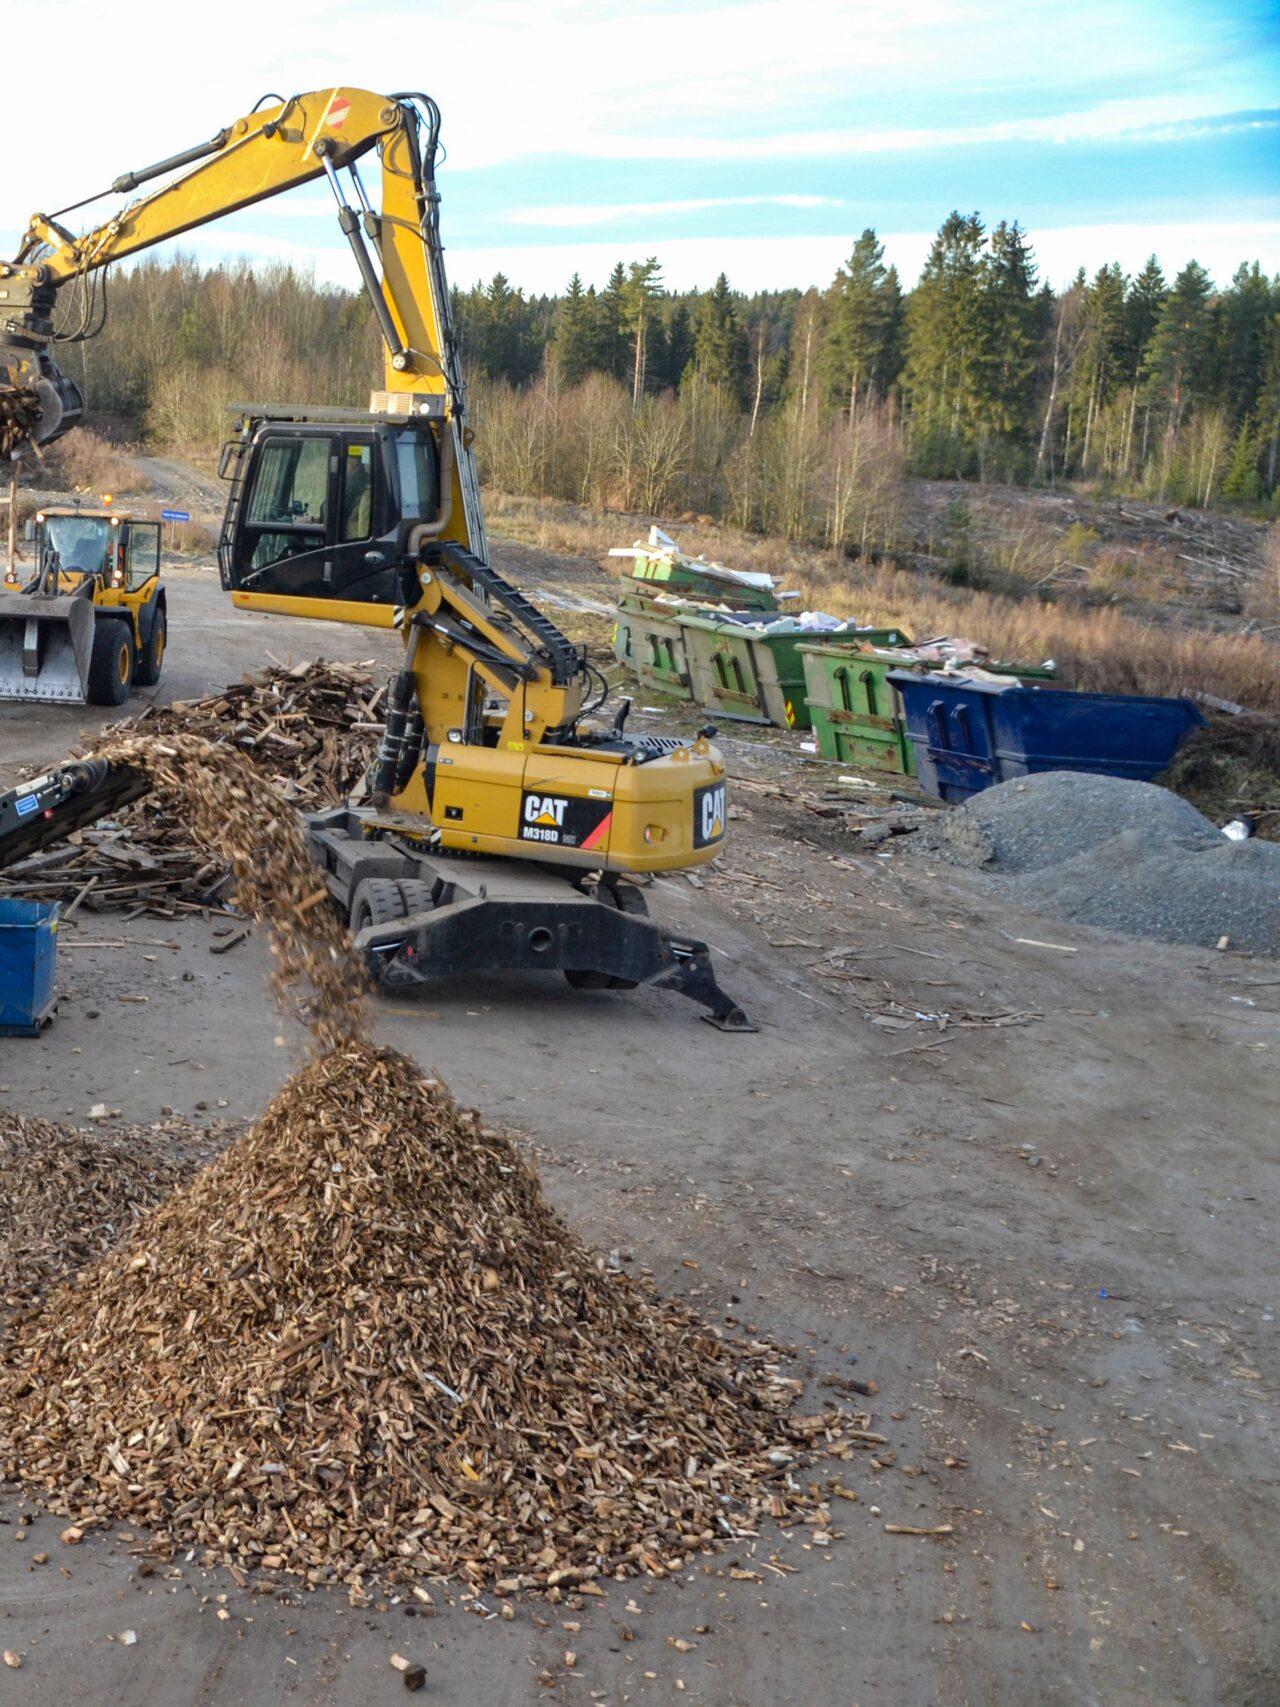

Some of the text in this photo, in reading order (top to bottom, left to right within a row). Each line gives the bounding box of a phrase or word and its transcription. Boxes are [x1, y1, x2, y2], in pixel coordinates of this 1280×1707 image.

[525, 795, 568, 826] CAT
[702, 787, 725, 840] CAT
[523, 826, 559, 842] M318D
